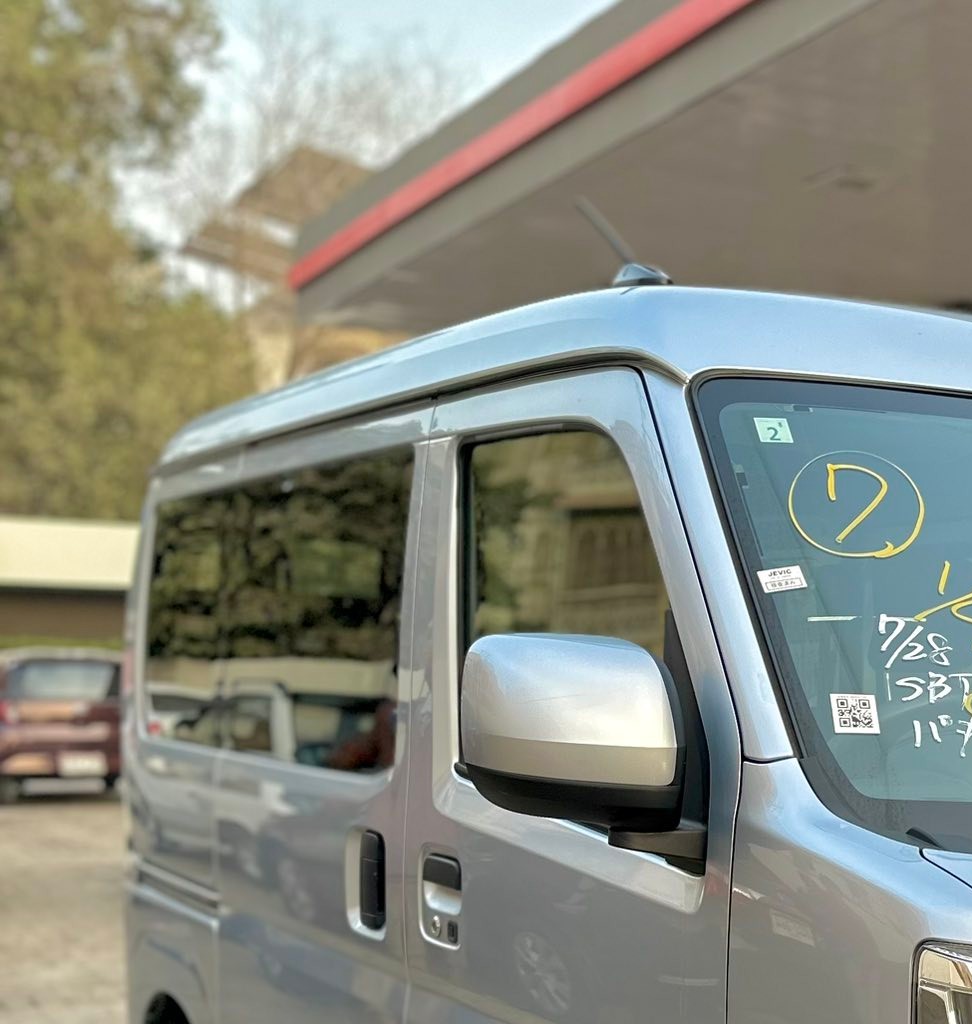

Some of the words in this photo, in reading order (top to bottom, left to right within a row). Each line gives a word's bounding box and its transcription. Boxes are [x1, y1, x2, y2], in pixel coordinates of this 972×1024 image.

[767, 426, 781, 441] 2
[768, 568, 792, 577] JEVIC
[878, 613, 953, 669] 7/28
